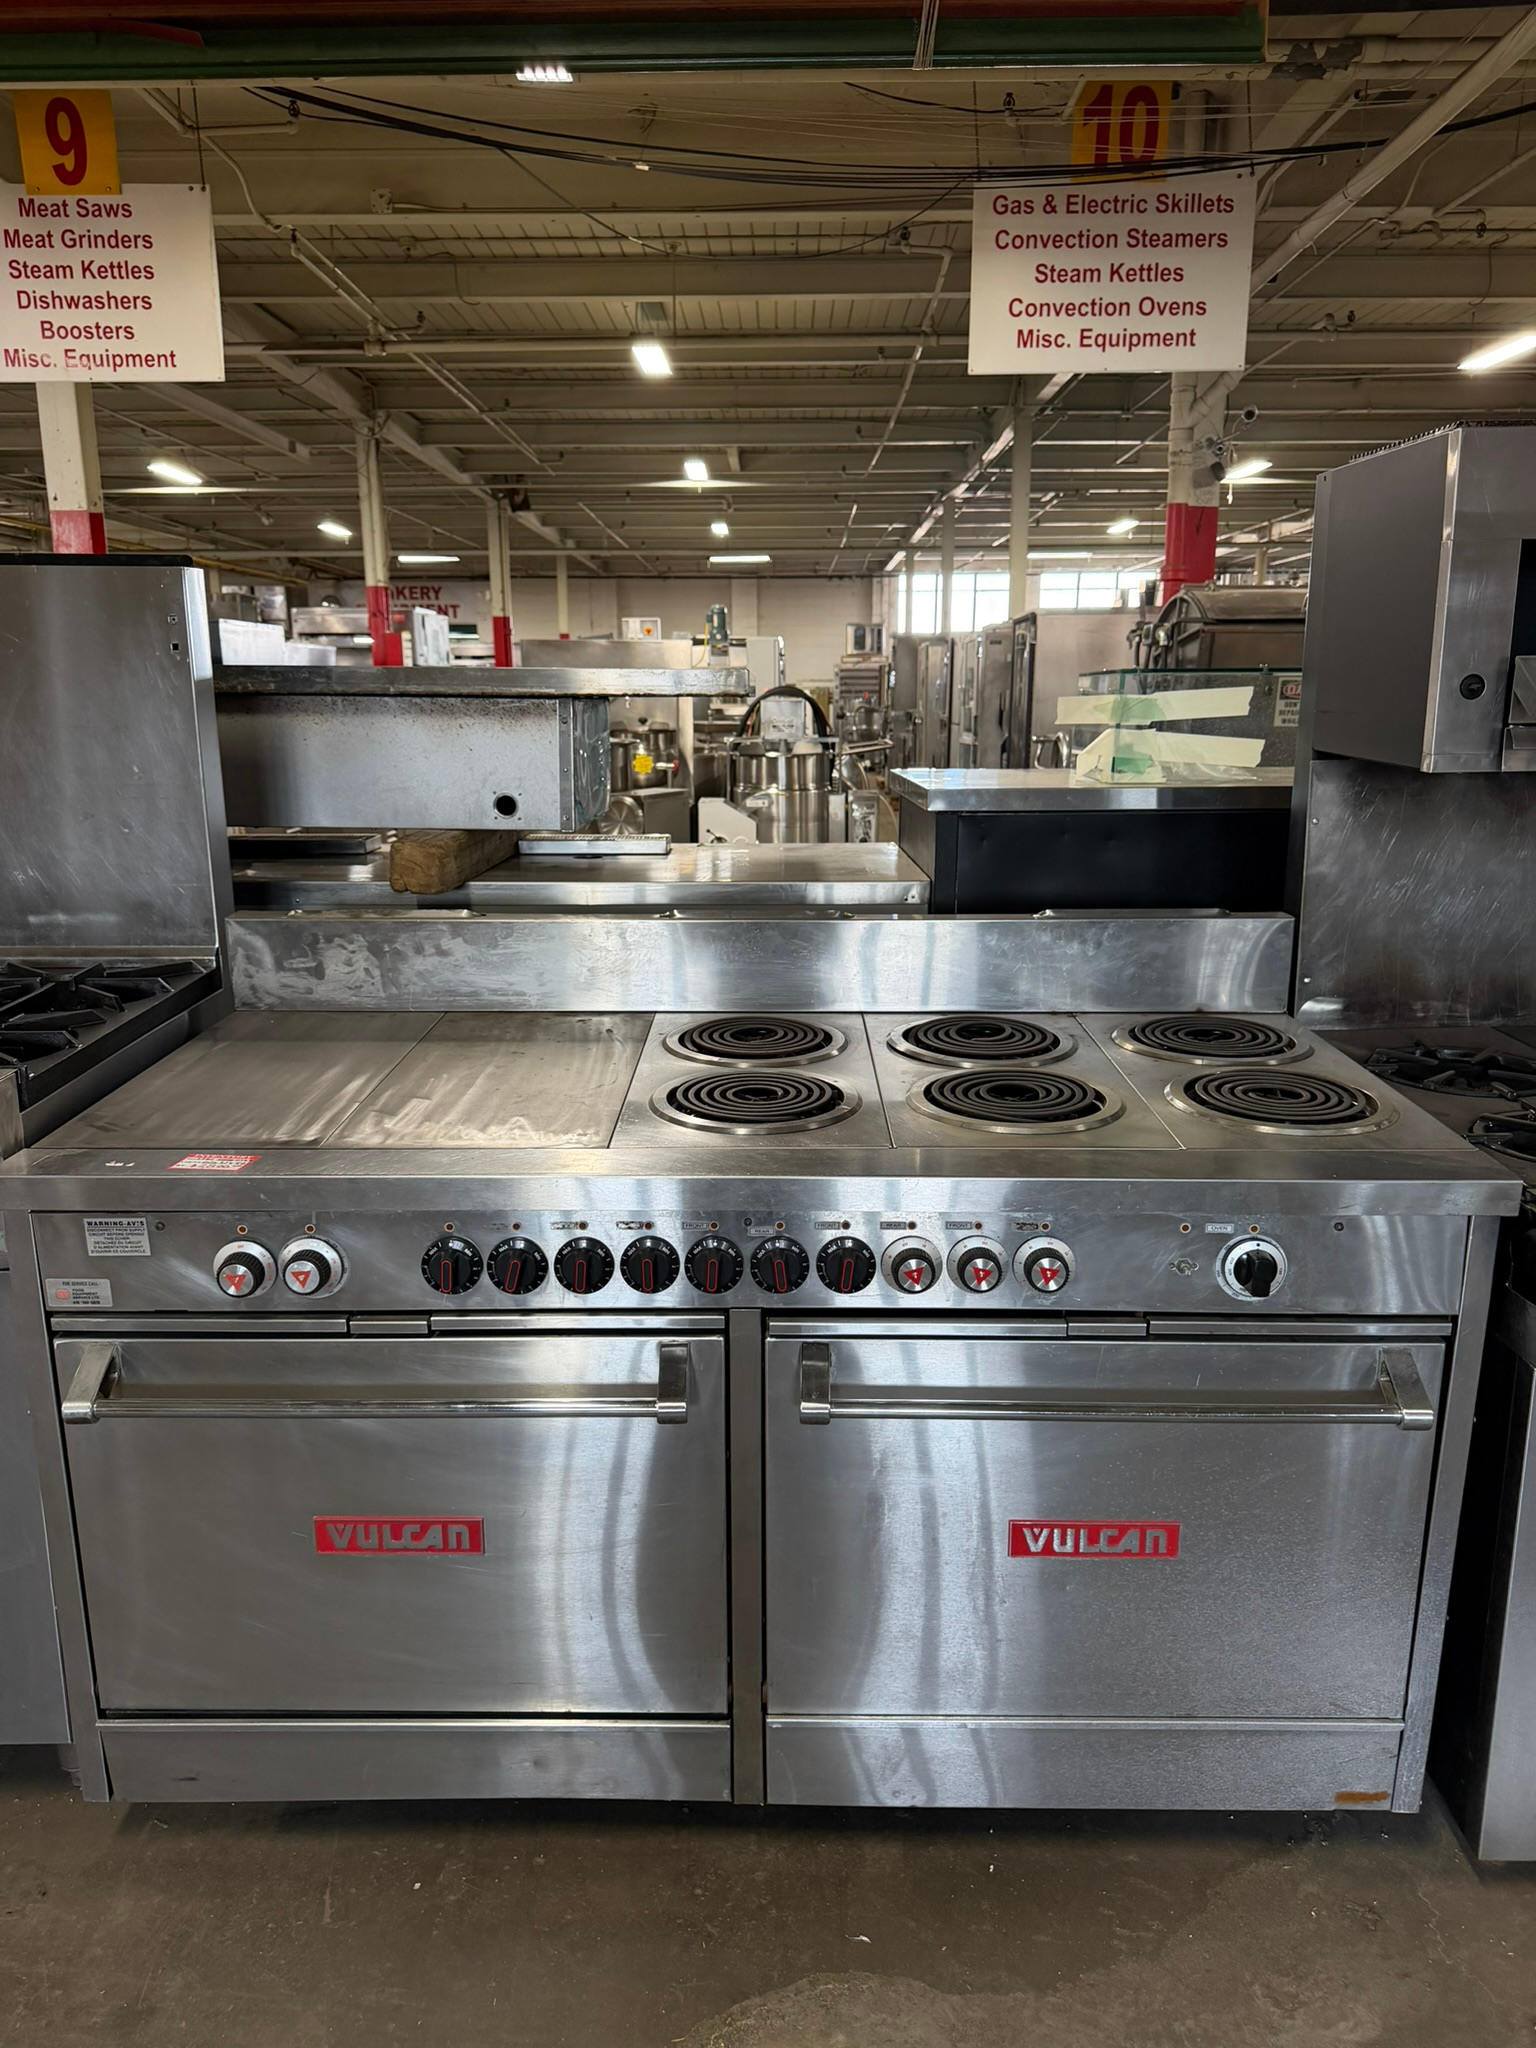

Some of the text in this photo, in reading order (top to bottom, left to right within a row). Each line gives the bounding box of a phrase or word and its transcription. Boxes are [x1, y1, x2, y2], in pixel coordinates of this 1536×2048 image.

[1083, 84, 1160, 173] 10
[45, 97, 87, 186] 9
[18, 198, 133, 218] Meat Saws
[993, 193, 1234, 215] Gas & Electric Skillets
[4, 229, 153, 249] Meat Grinders
[995, 228, 1228, 249] Convection Steamers
[9, 260, 154, 279] Steam Kettles
[1035, 263, 1184, 283] Steam Kettles
[16, 290, 152, 310] Dishwashers
[1009, 296, 1207, 317] Convection Ovens
[40, 321, 135, 340] Boosters
[1016, 328, 1196, 352] Misc. Equipment
[4, 349, 177, 372] Misc. Equipment
[390, 586, 443, 600] KERY
[326, 1524, 470, 1549] VULCAN
[1022, 1528, 1167, 1553] VULCAN
